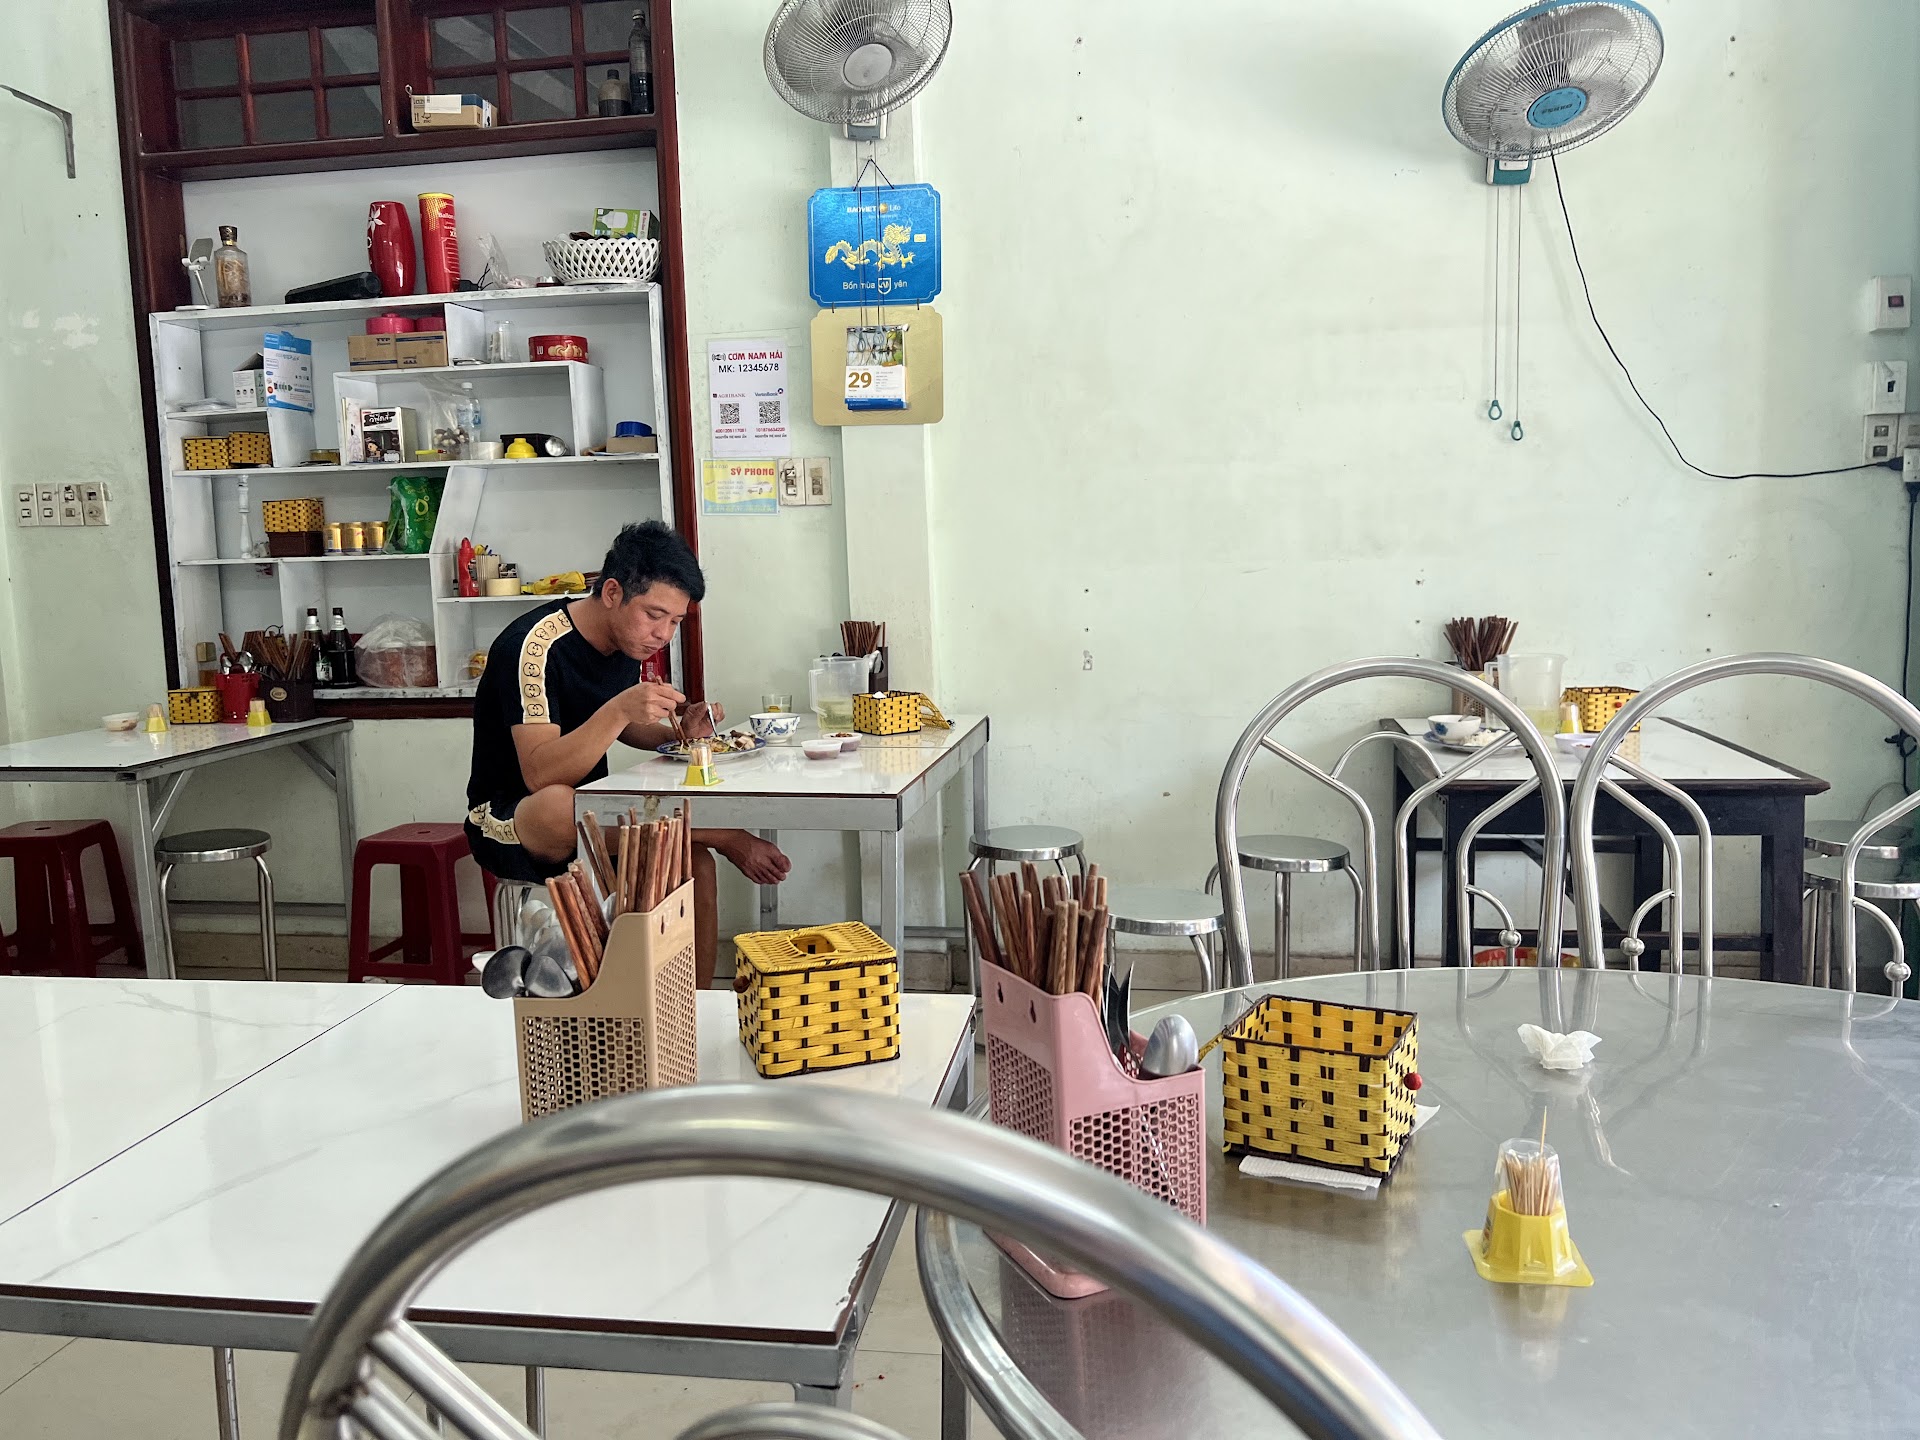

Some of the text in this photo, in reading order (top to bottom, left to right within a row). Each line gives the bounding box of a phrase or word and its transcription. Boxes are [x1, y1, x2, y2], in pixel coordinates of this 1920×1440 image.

[842, 280, 858, 290] Bốn
[893, 279, 908, 289] yên
[728, 349, 783, 361] CƠM NAM HẢI
[718, 362, 779, 373] MK: 12345678
[848, 371, 872, 389] 29
[744, 467, 775, 476] PHONG
